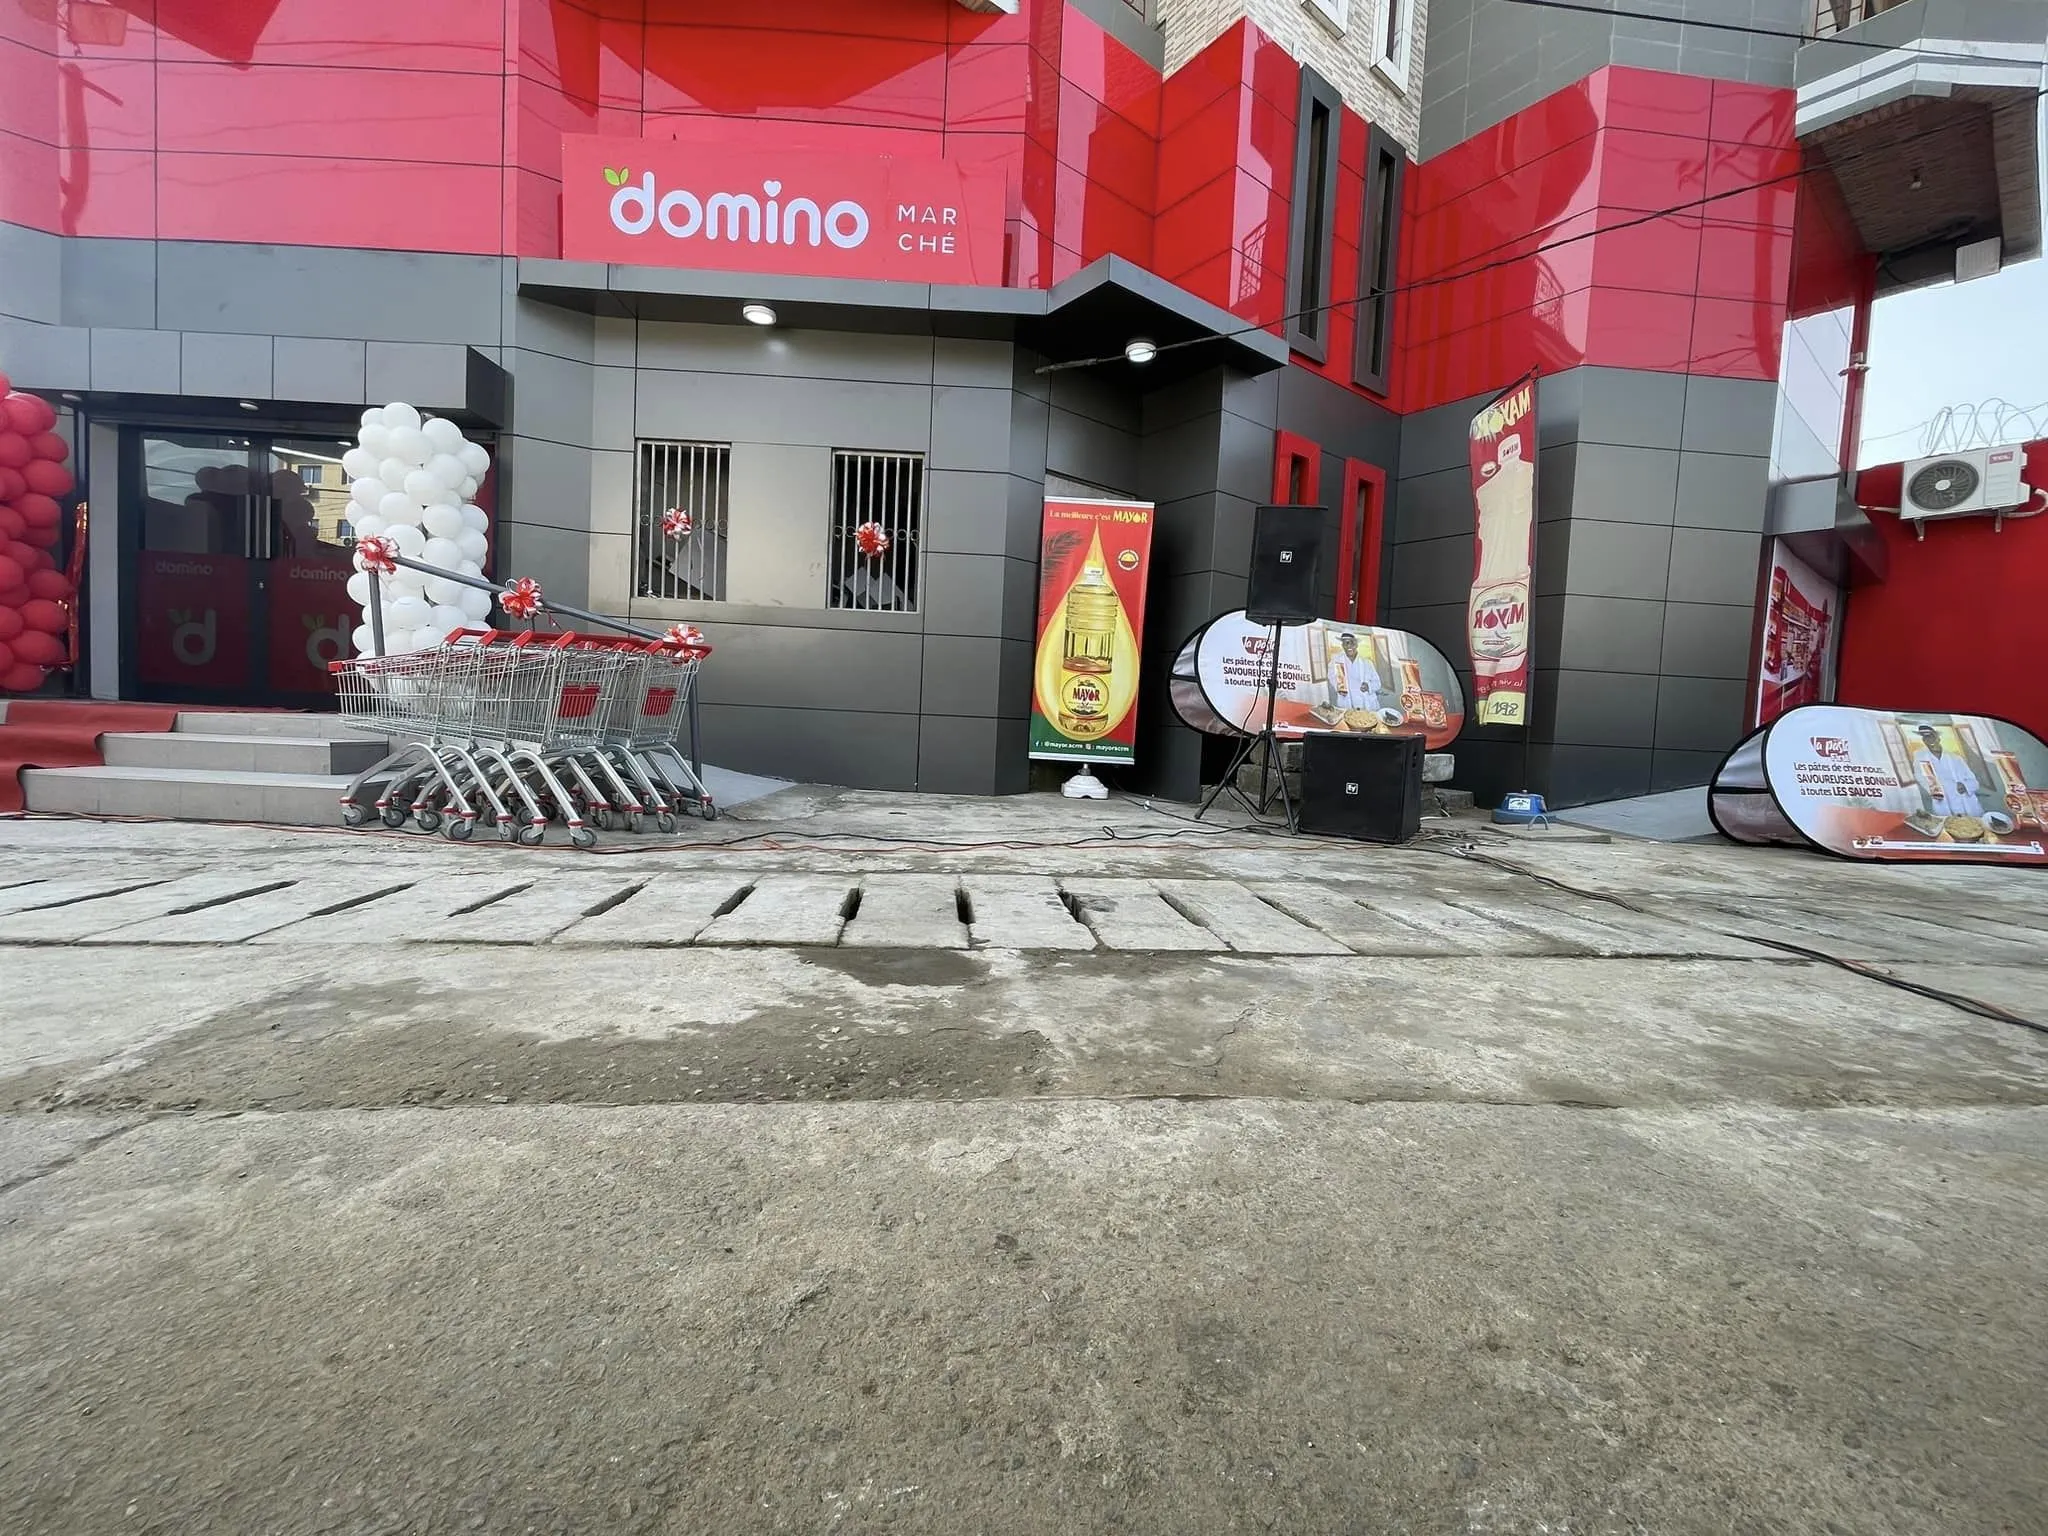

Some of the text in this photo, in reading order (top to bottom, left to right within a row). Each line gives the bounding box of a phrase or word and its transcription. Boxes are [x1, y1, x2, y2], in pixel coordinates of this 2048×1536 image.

[609, 171, 870, 250] domino
[898, 204, 957, 225] MAR
[898, 232, 956, 254] CHÉ
[1113, 509, 1149, 524] MAYOR
[156, 560, 213, 576] domino
[290, 566, 348, 582] domino
[1223, 656, 1234, 664] Les
[1235, 657, 1255, 666] pâtes
[1223, 666, 1273, 678] SAVOUREUSES
[1282, 671, 1311, 682] BONNES
[1230, 678, 1252, 686] toutes
[1072, 687, 1100, 702] MAYOR
[1794, 762, 1807, 771] Les
[1807, 762, 1830, 772] pâtes
[1831, 763, 1842, 772] de
[1843, 764, 1861, 773] chez
[1796, 773, 1898, 787] SAVOUREUSES et BONNES
[1807, 787, 1832, 796] toutes
[1832, 786, 1847, 796] LES
[1848, 788, 1883, 798] SAUCES
